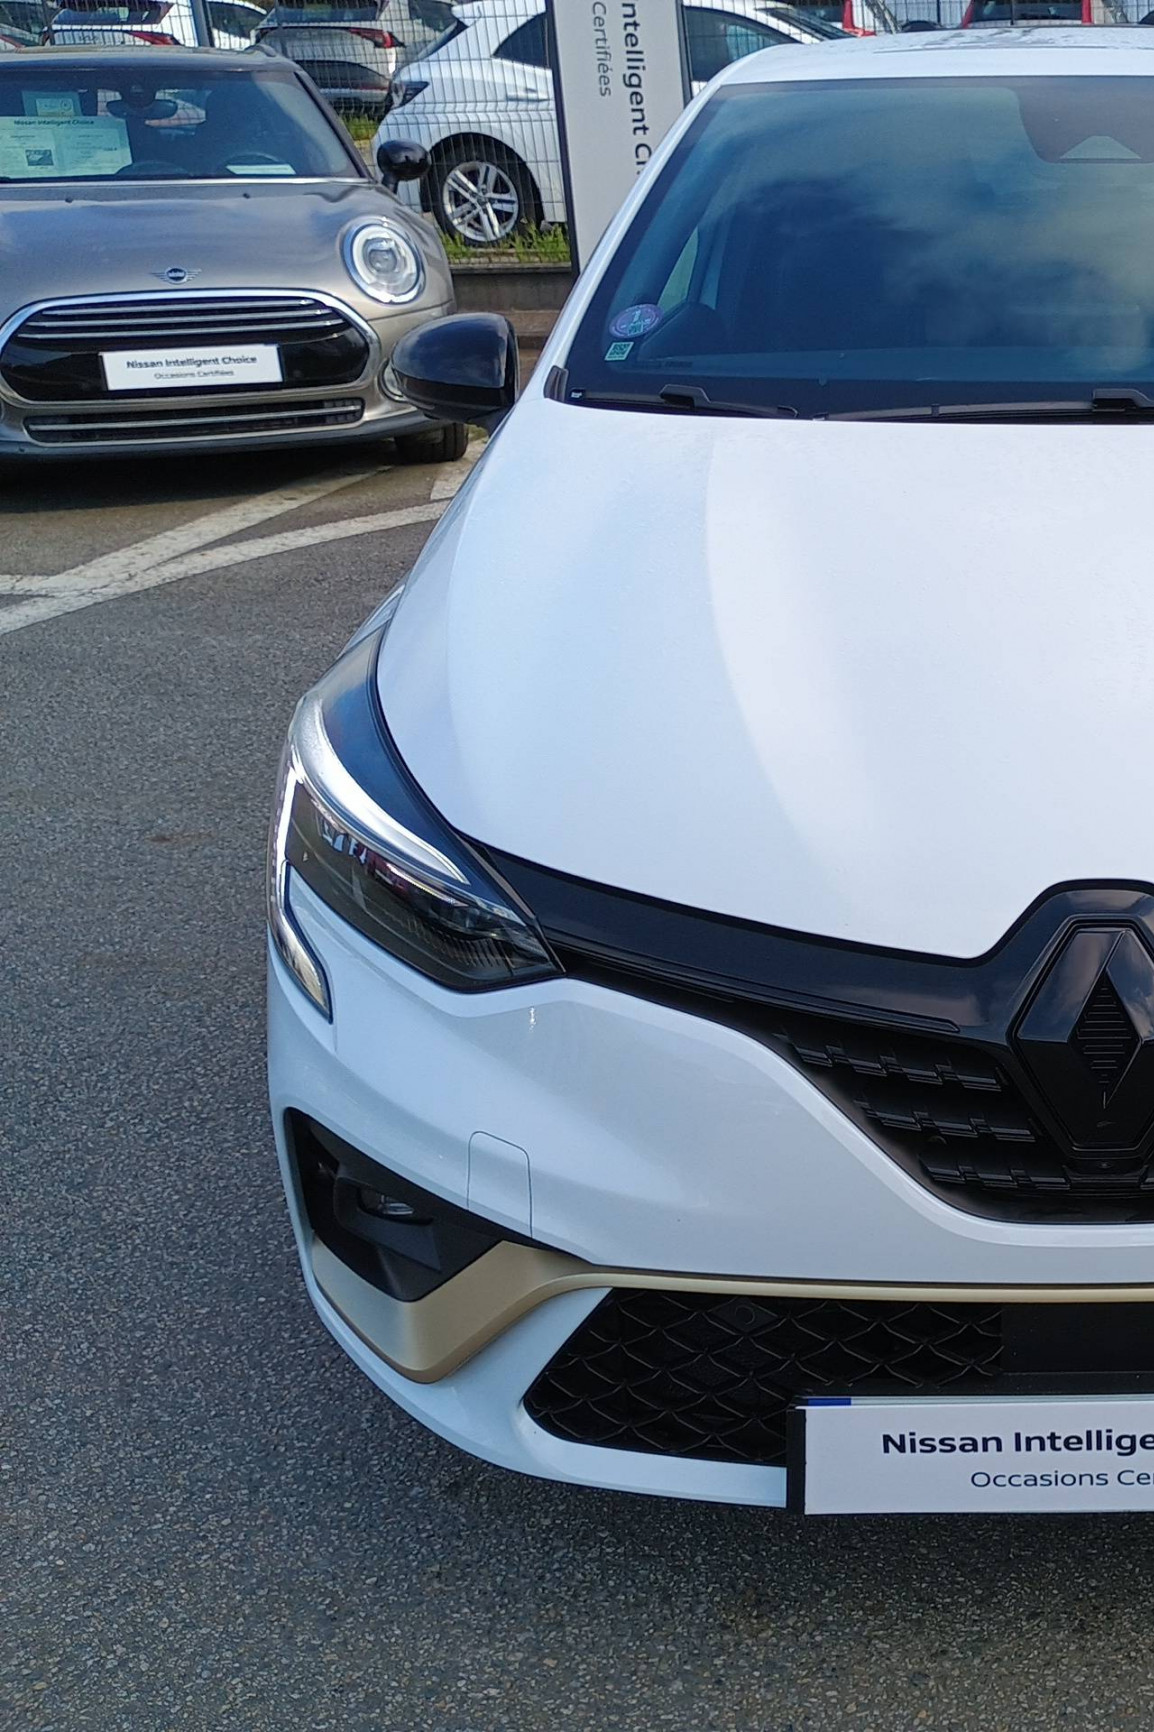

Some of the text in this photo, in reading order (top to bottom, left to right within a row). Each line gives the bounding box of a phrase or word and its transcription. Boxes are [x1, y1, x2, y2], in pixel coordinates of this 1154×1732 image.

[592, 1, 613, 97] Certifiées
[622, 0, 650, 136] ntelligent
[126, 355, 257, 369] Nissan Intelligent Choice
[154, 371, 195, 379] Occasions
[882, 1432, 1003, 1454] Nissan
[970, 1470, 1109, 1488] Occasions
